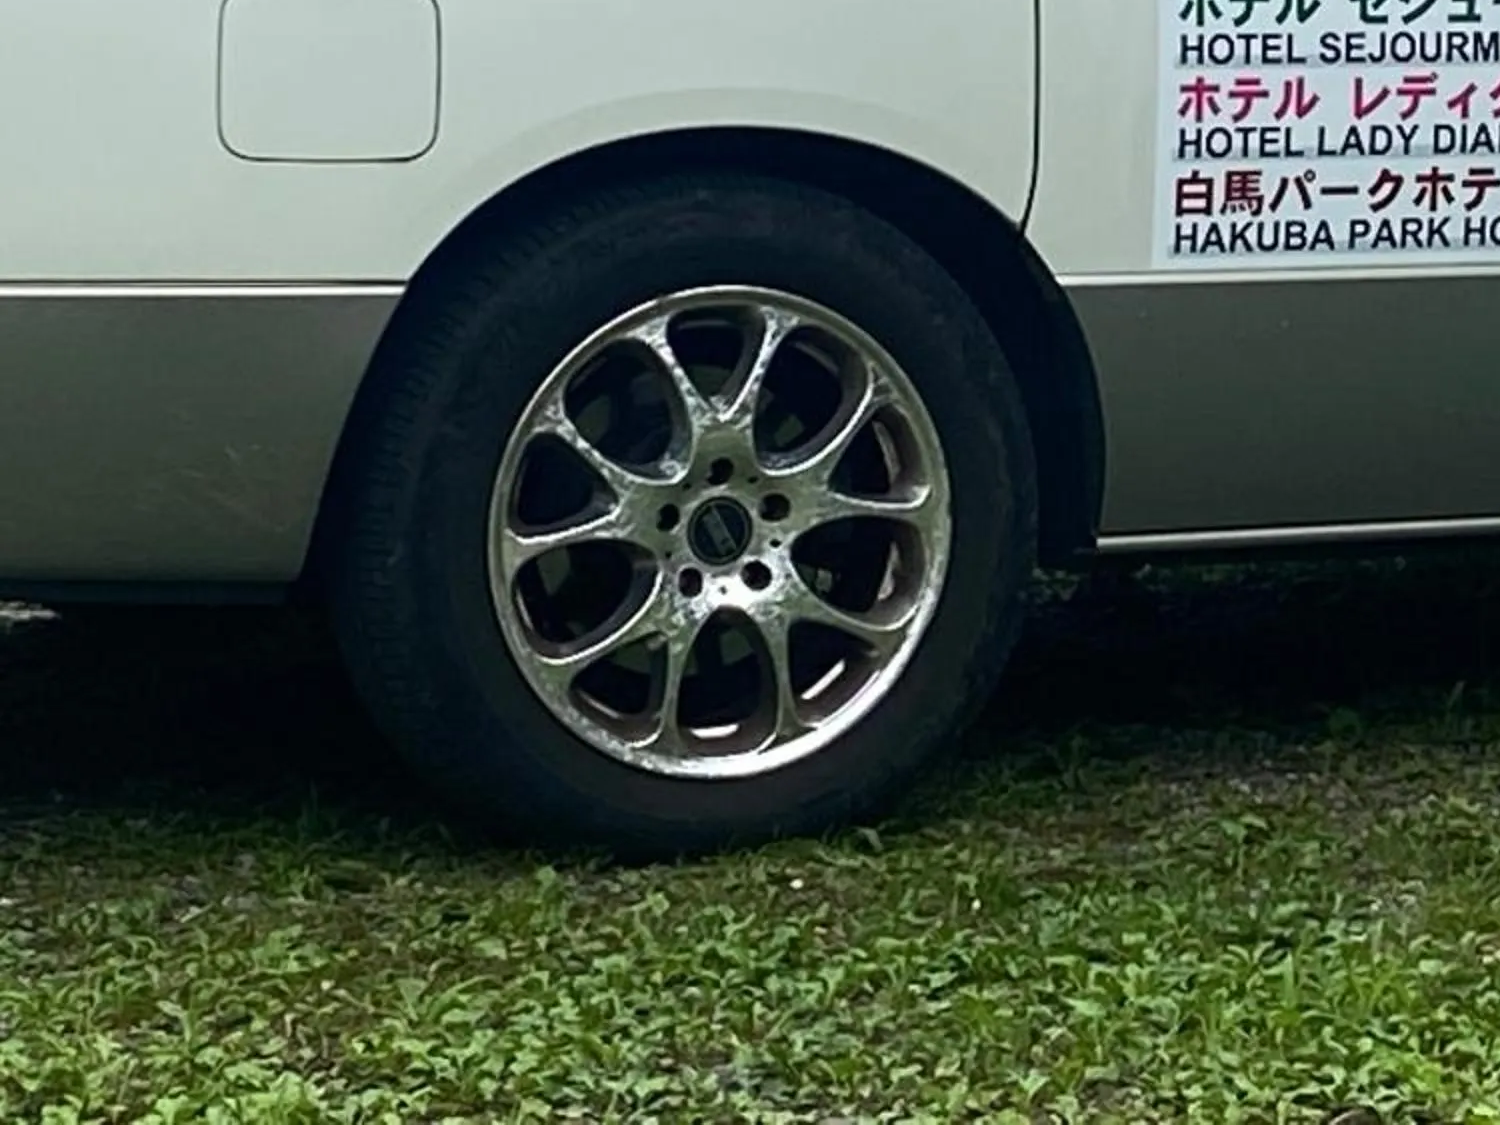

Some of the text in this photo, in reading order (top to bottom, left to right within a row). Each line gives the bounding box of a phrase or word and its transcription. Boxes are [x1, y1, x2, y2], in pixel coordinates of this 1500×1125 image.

[1180, 33, 1307, 66] HOTEL
[1178, 75, 1320, 123] ホテル
[1177, 126, 1306, 161] HOTEL
[1316, 124, 1420, 158] LADY
[1172, 220, 1335, 254] HAKUBA
[1347, 217, 1451, 250] PARK
